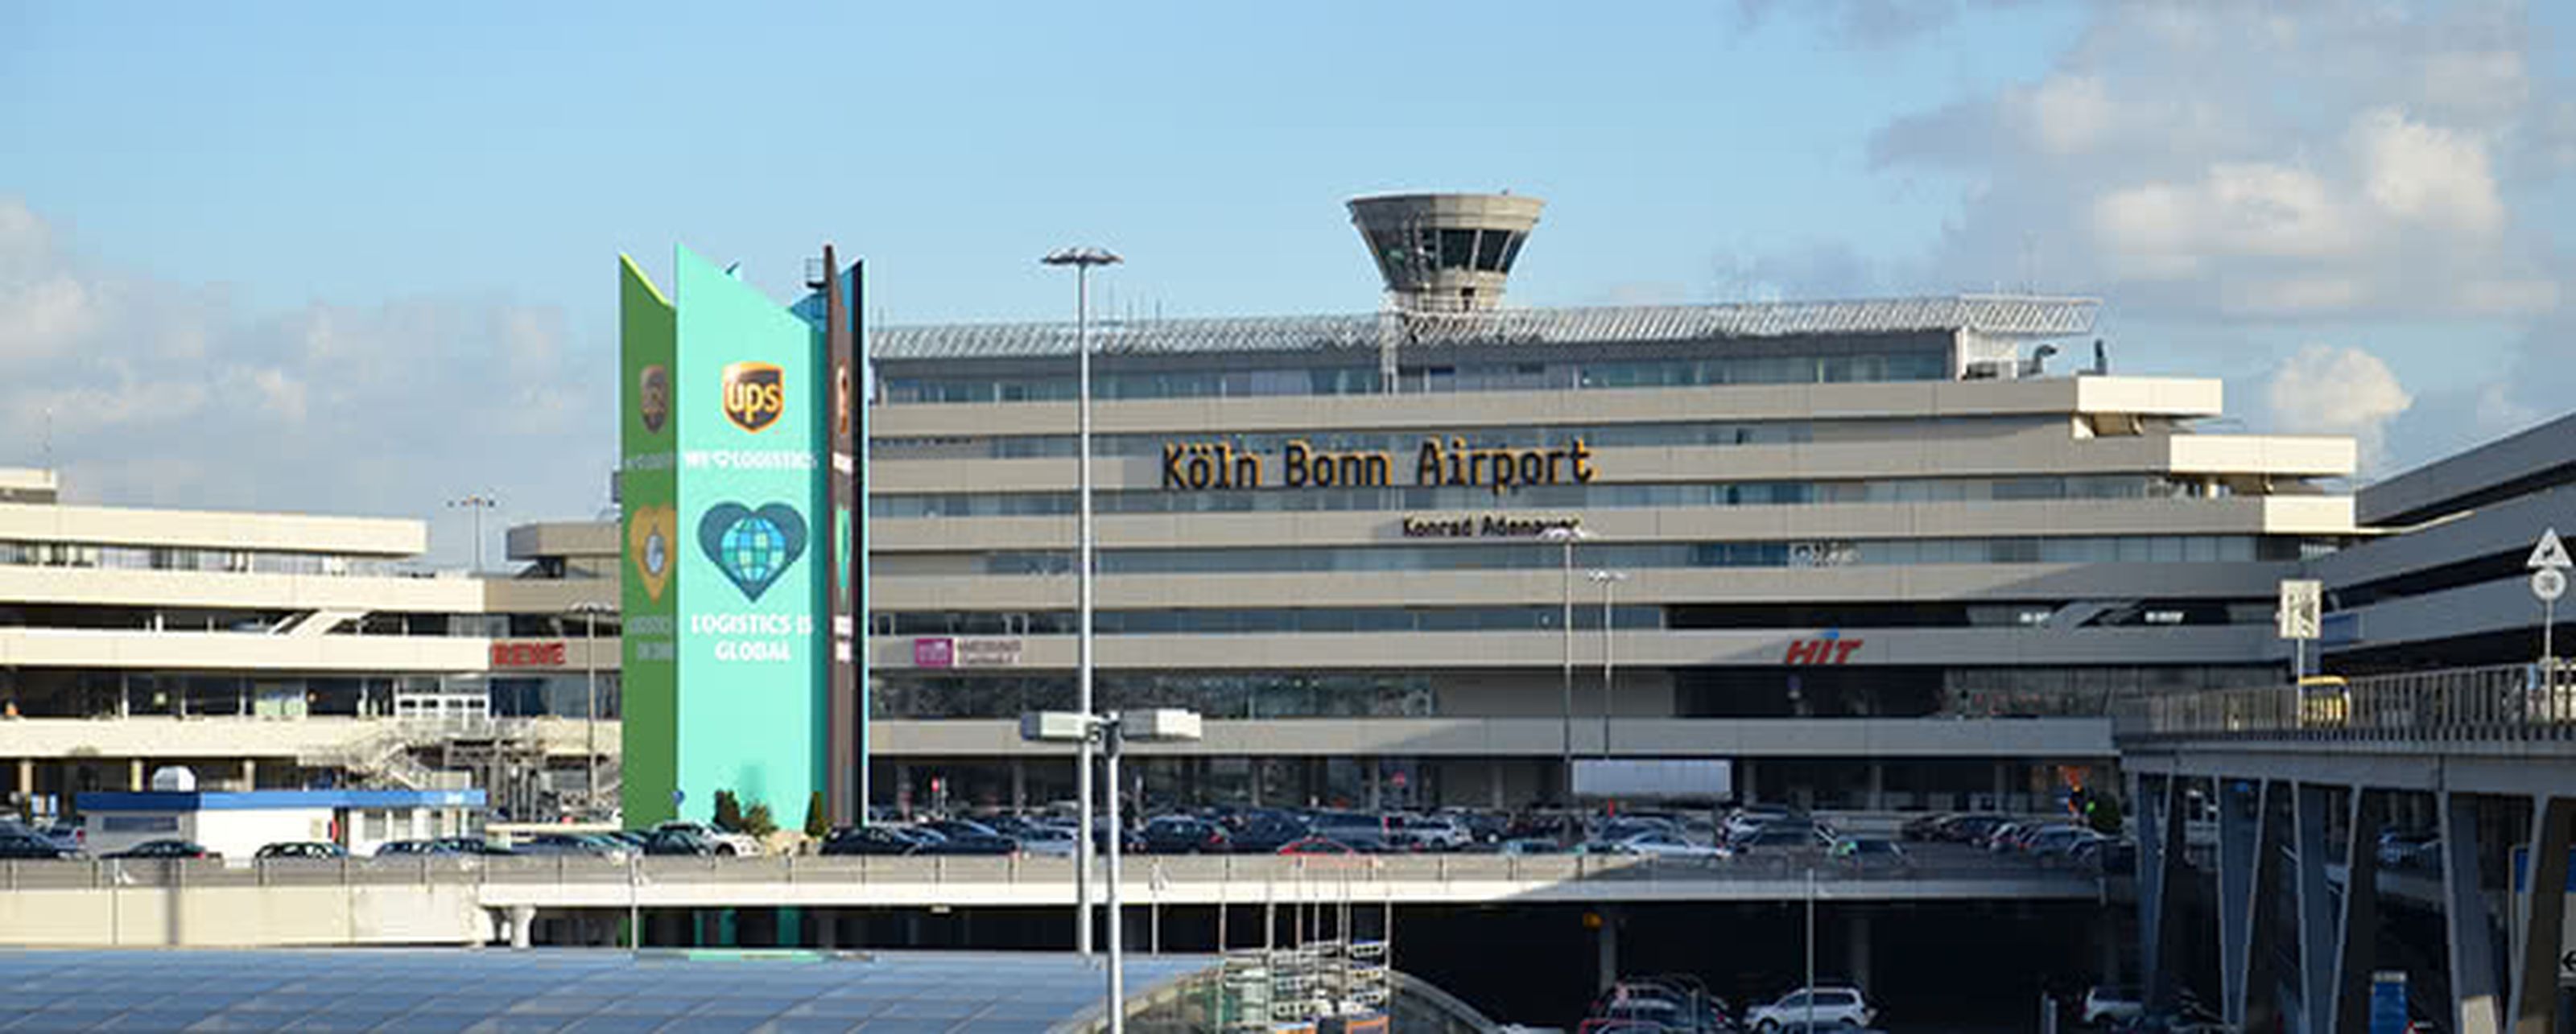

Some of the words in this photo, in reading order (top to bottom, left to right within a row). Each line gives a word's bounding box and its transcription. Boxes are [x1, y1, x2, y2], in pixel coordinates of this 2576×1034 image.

[726, 381, 780, 423] ups
[1162, 440, 1263, 490] Köln
[1284, 439, 1393, 488] Bonn
[1416, 436, 1602, 496] Airport
[1403, 513, 1472, 537] Konrad
[691, 612, 792, 636] LOGISTICS
[492, 641, 567, 666] REWE
[715, 640, 791, 662] GLOBAL
[1785, 638, 1864, 665] HIT
